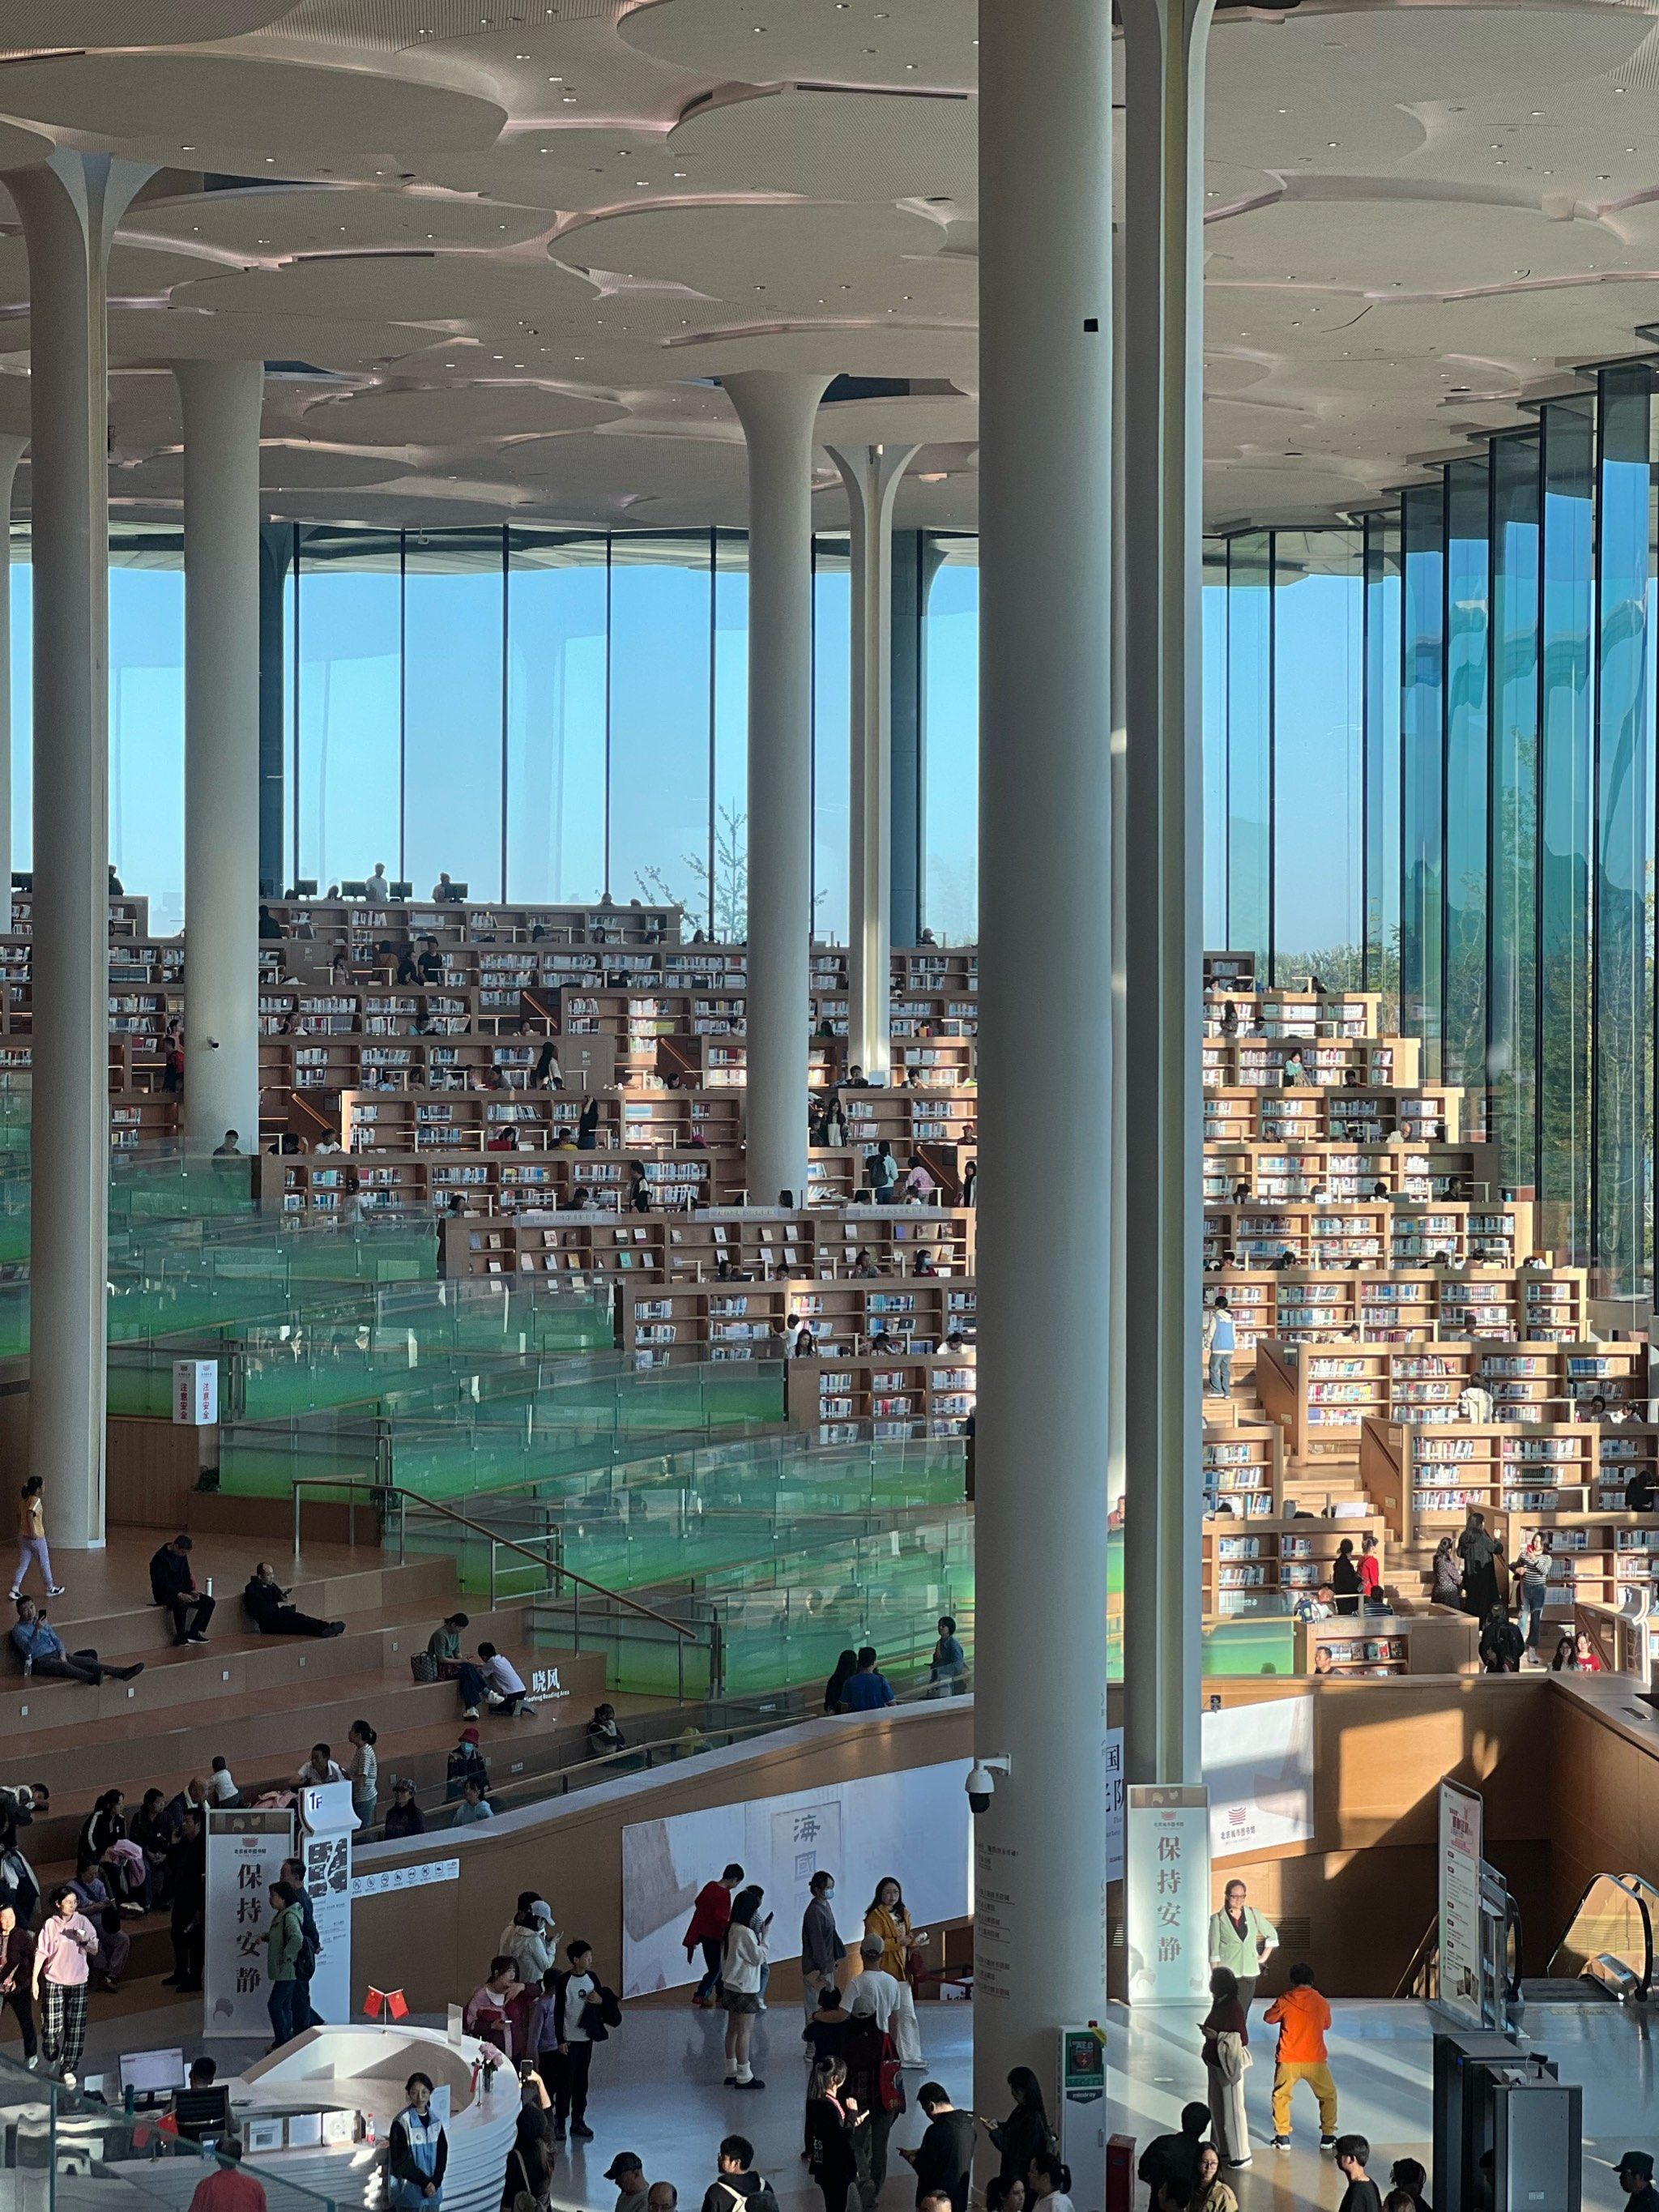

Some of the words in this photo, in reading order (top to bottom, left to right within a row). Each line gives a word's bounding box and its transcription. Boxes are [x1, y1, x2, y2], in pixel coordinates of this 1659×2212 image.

[532, 1668, 560, 1693] 晓风
[309, 1792, 323, 1810] 1F
[1157, 1836, 1183, 1962] 保持安静
[237, 1863, 262, 1993] 保持安静
[1076, 2041, 1094, 2049] AED
